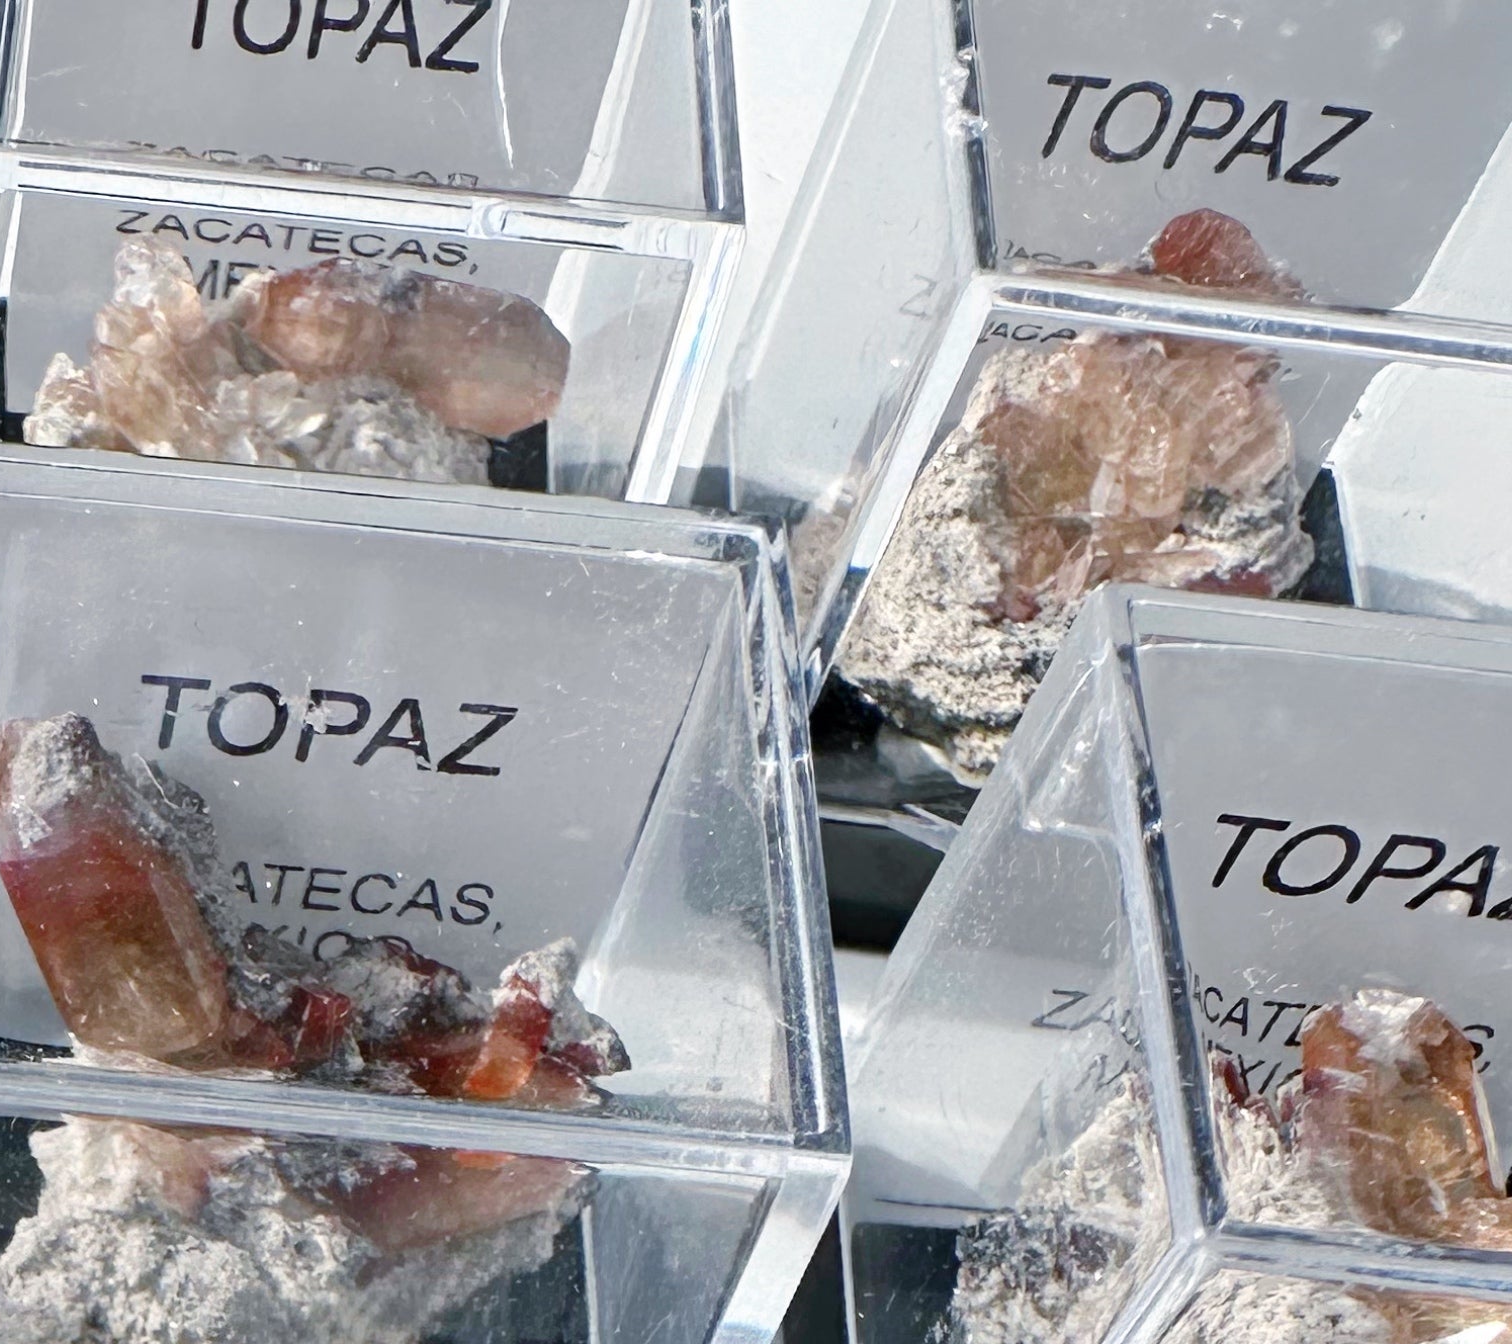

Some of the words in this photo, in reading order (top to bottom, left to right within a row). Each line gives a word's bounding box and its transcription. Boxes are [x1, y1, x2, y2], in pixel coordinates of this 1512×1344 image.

[1041, 73, 1373, 188] TOPAZ
[116, 209, 480, 276] ZACATECAS,
[140, 674, 519, 777] TOPAZ
[231, 860, 504, 936] ATECAS,
